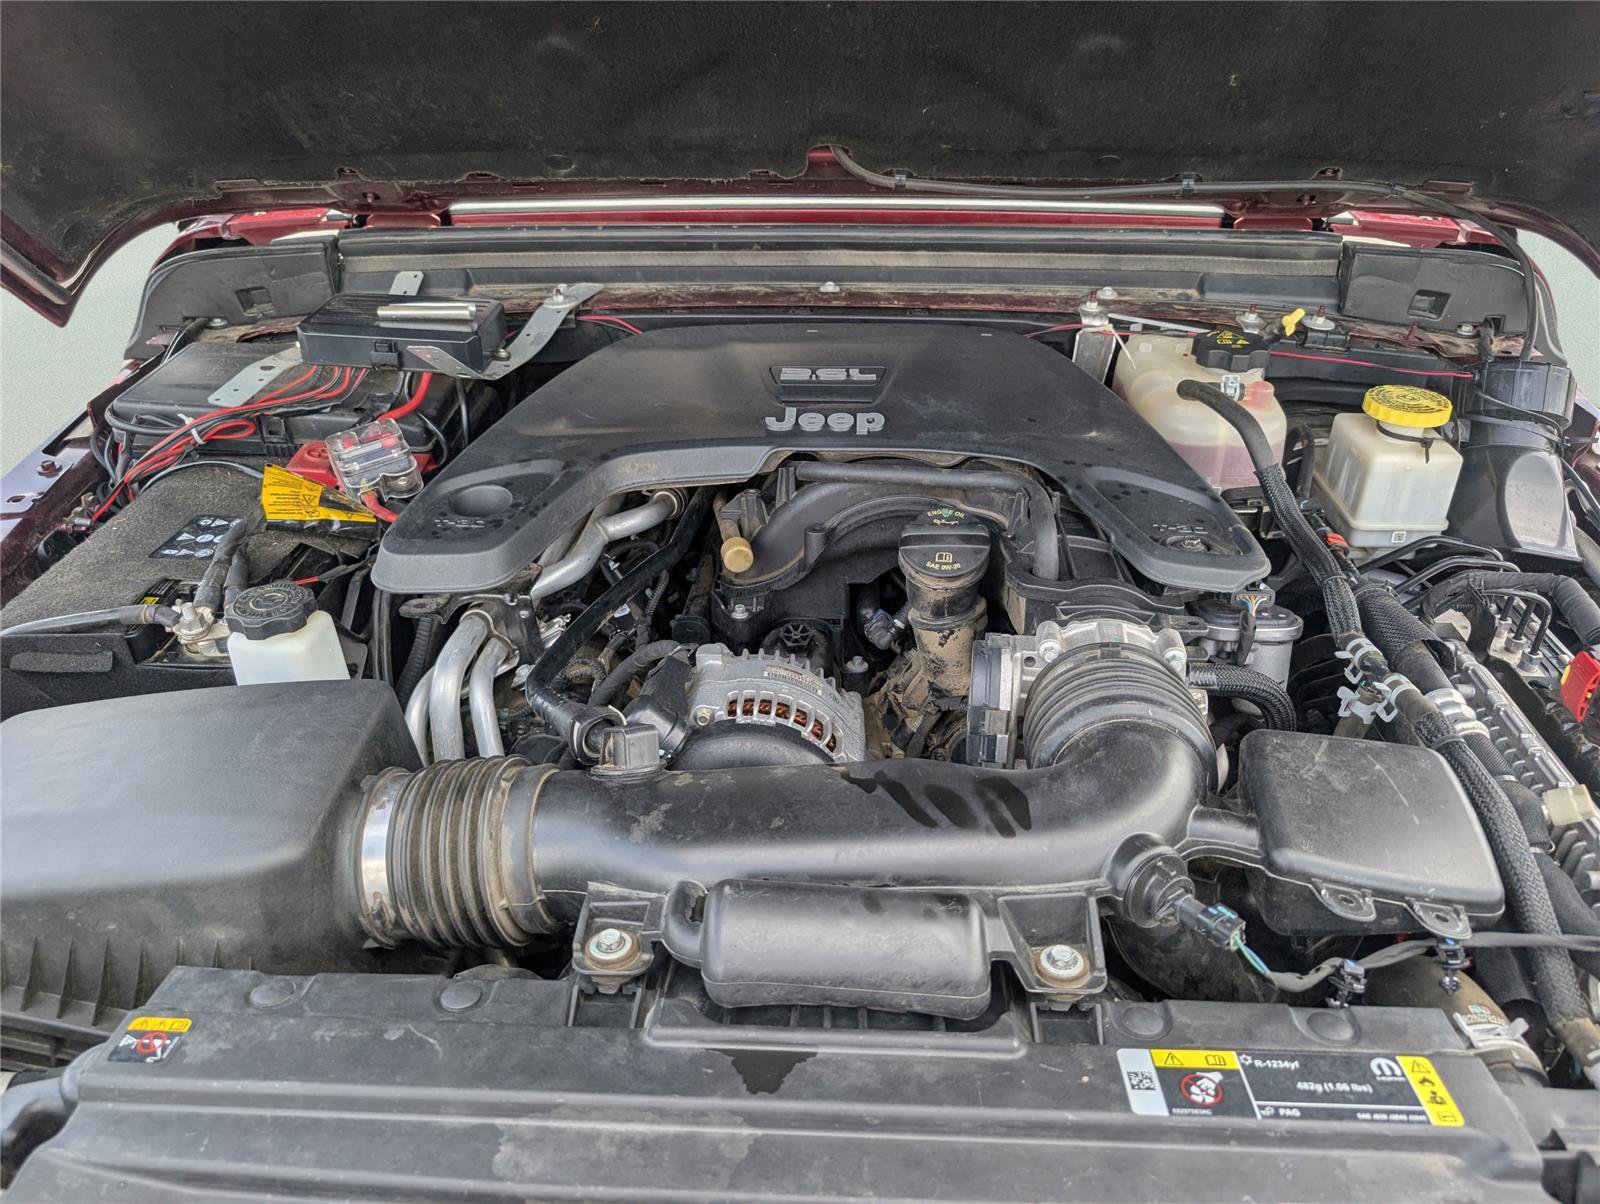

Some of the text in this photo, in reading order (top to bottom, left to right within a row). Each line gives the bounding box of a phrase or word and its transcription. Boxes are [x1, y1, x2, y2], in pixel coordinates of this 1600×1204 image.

[764, 407, 886, 435] Jeep
[927, 508, 965, 519] ENGE OIL
[925, 561, 940, 570] SAE
